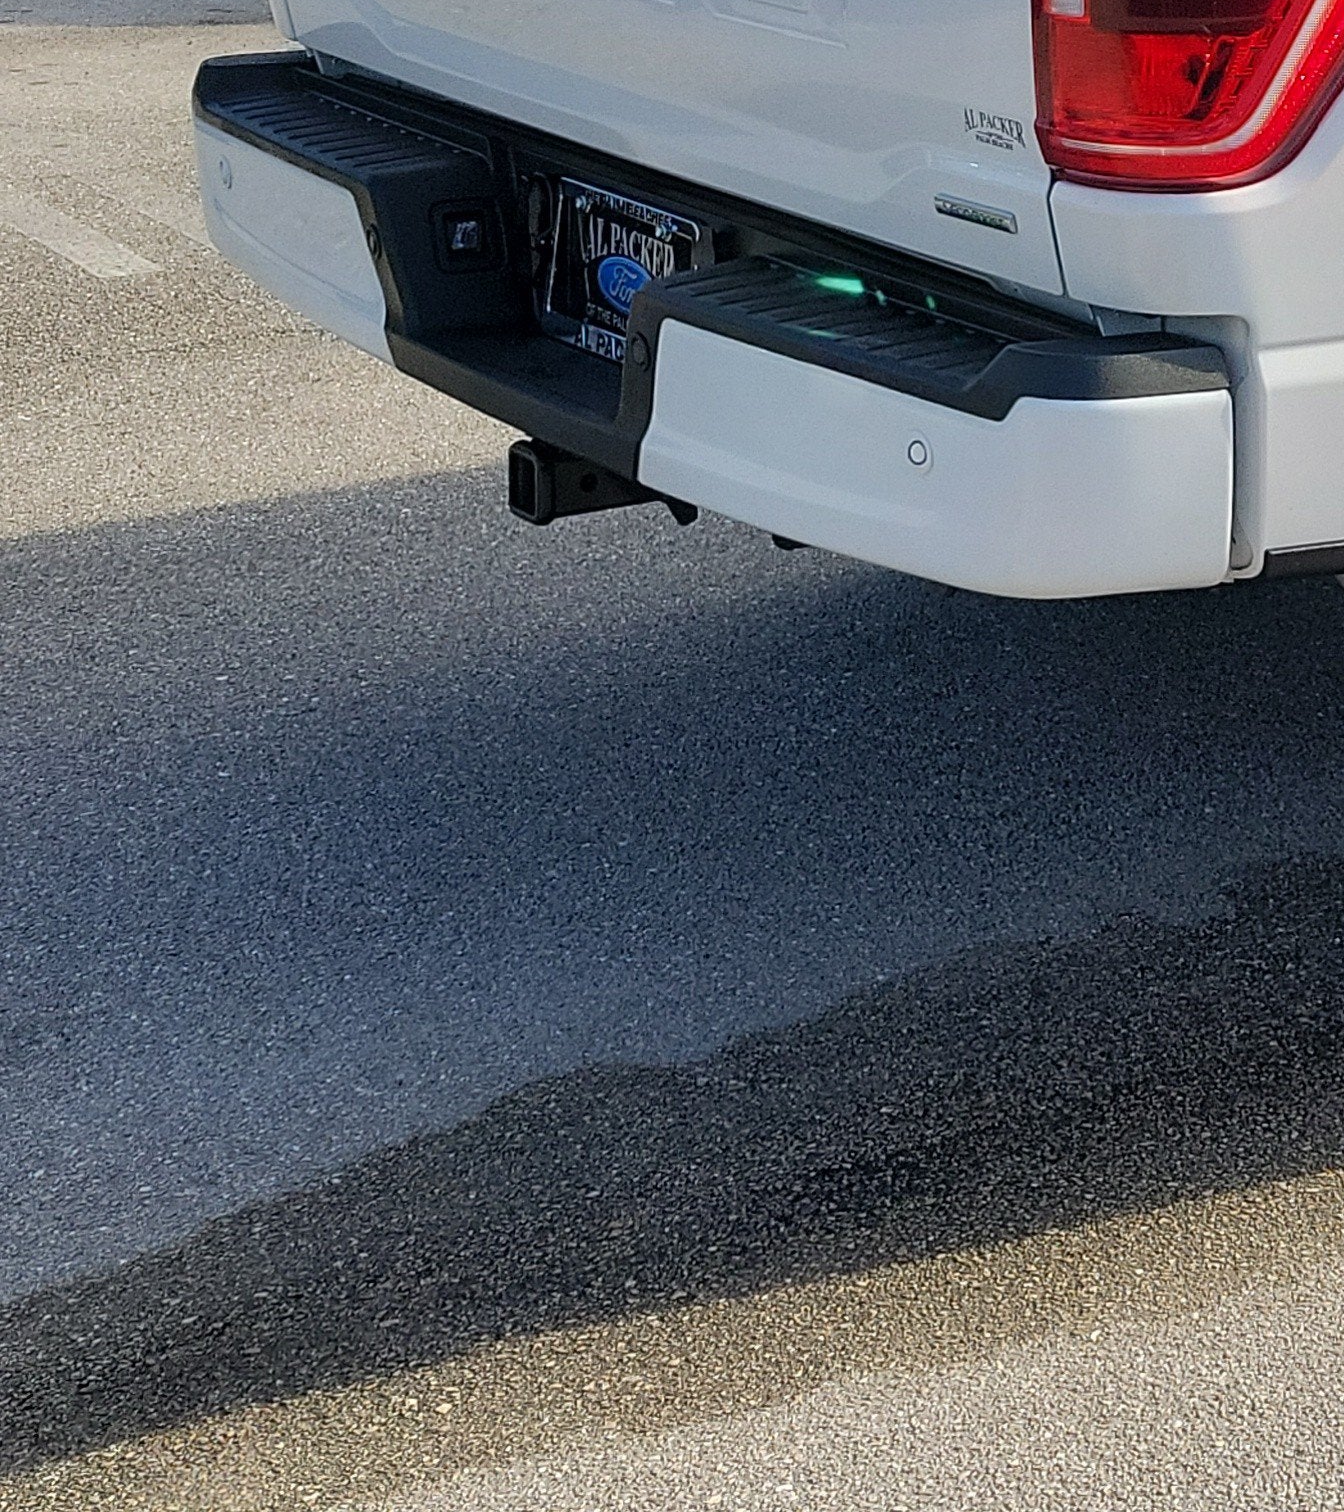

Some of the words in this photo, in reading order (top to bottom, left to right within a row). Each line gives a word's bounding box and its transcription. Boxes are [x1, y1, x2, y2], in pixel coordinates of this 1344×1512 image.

[963, 107, 978, 132] AL
[979, 111, 1026, 148] PACKER
[584, 214, 608, 261] AL
[608, 265, 637, 303] For
[597, 306, 611, 325] THE
[575, 324, 592, 349] AL
